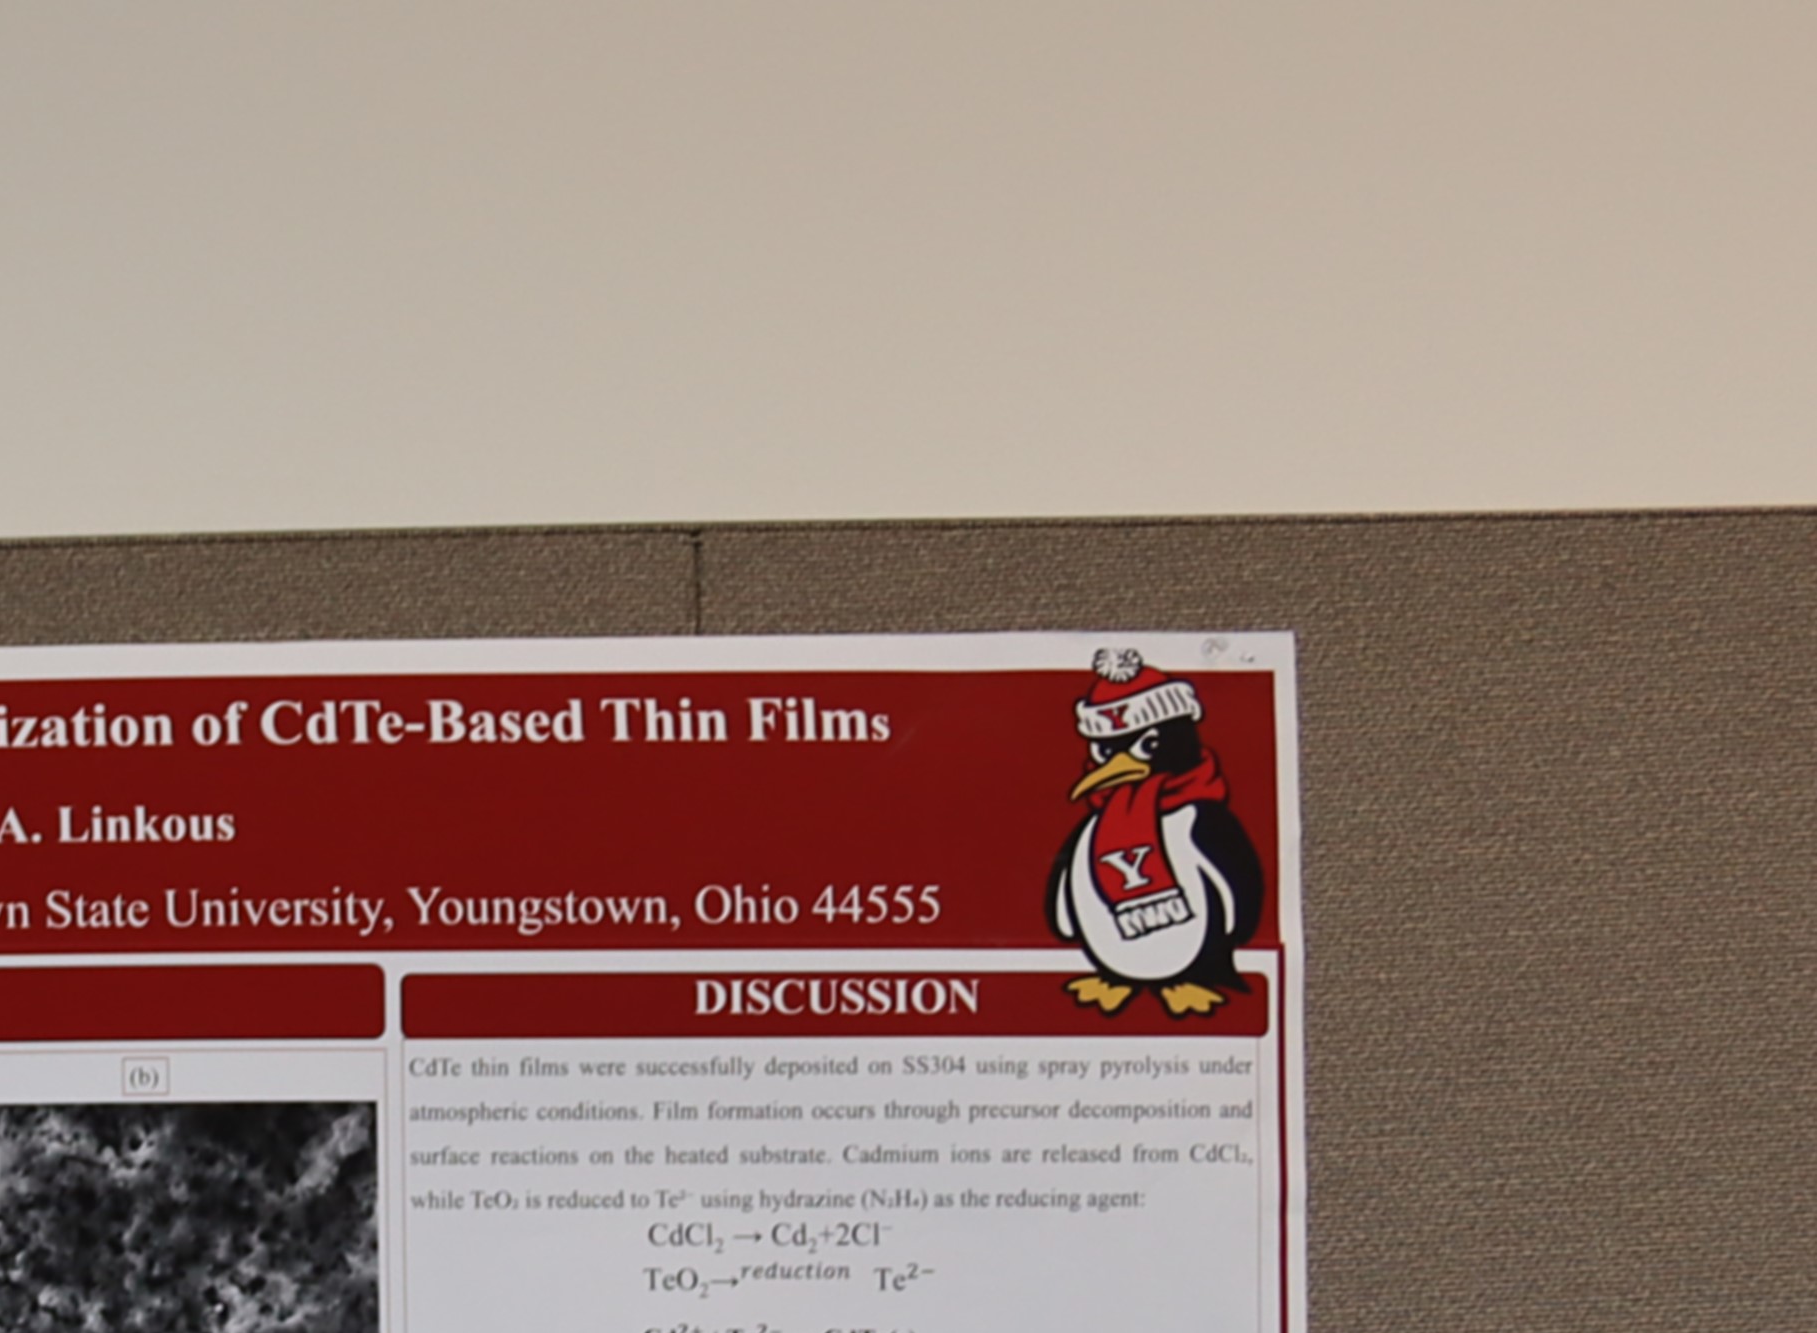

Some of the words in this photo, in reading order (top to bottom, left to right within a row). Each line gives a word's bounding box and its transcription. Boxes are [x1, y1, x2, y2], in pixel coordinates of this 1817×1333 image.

[192, 701, 250, 748] of
[261, 699, 586, 748] CdTe-Based
[600, 697, 729, 744] Thin
[749, 697, 892, 744] Films
[59, 805, 237, 845] Linkous
[1100, 845, 1152, 891] Y
[46, 893, 150, 931] State
[166, 889, 395, 938] University,
[408, 888, 682, 938] Youngstown,
[695, 884, 800, 926] Ohio
[812, 885, 941, 926] 44555
[697, 979, 980, 1017] DISCUSSION
[130, 1066, 161, 1090] (b)
